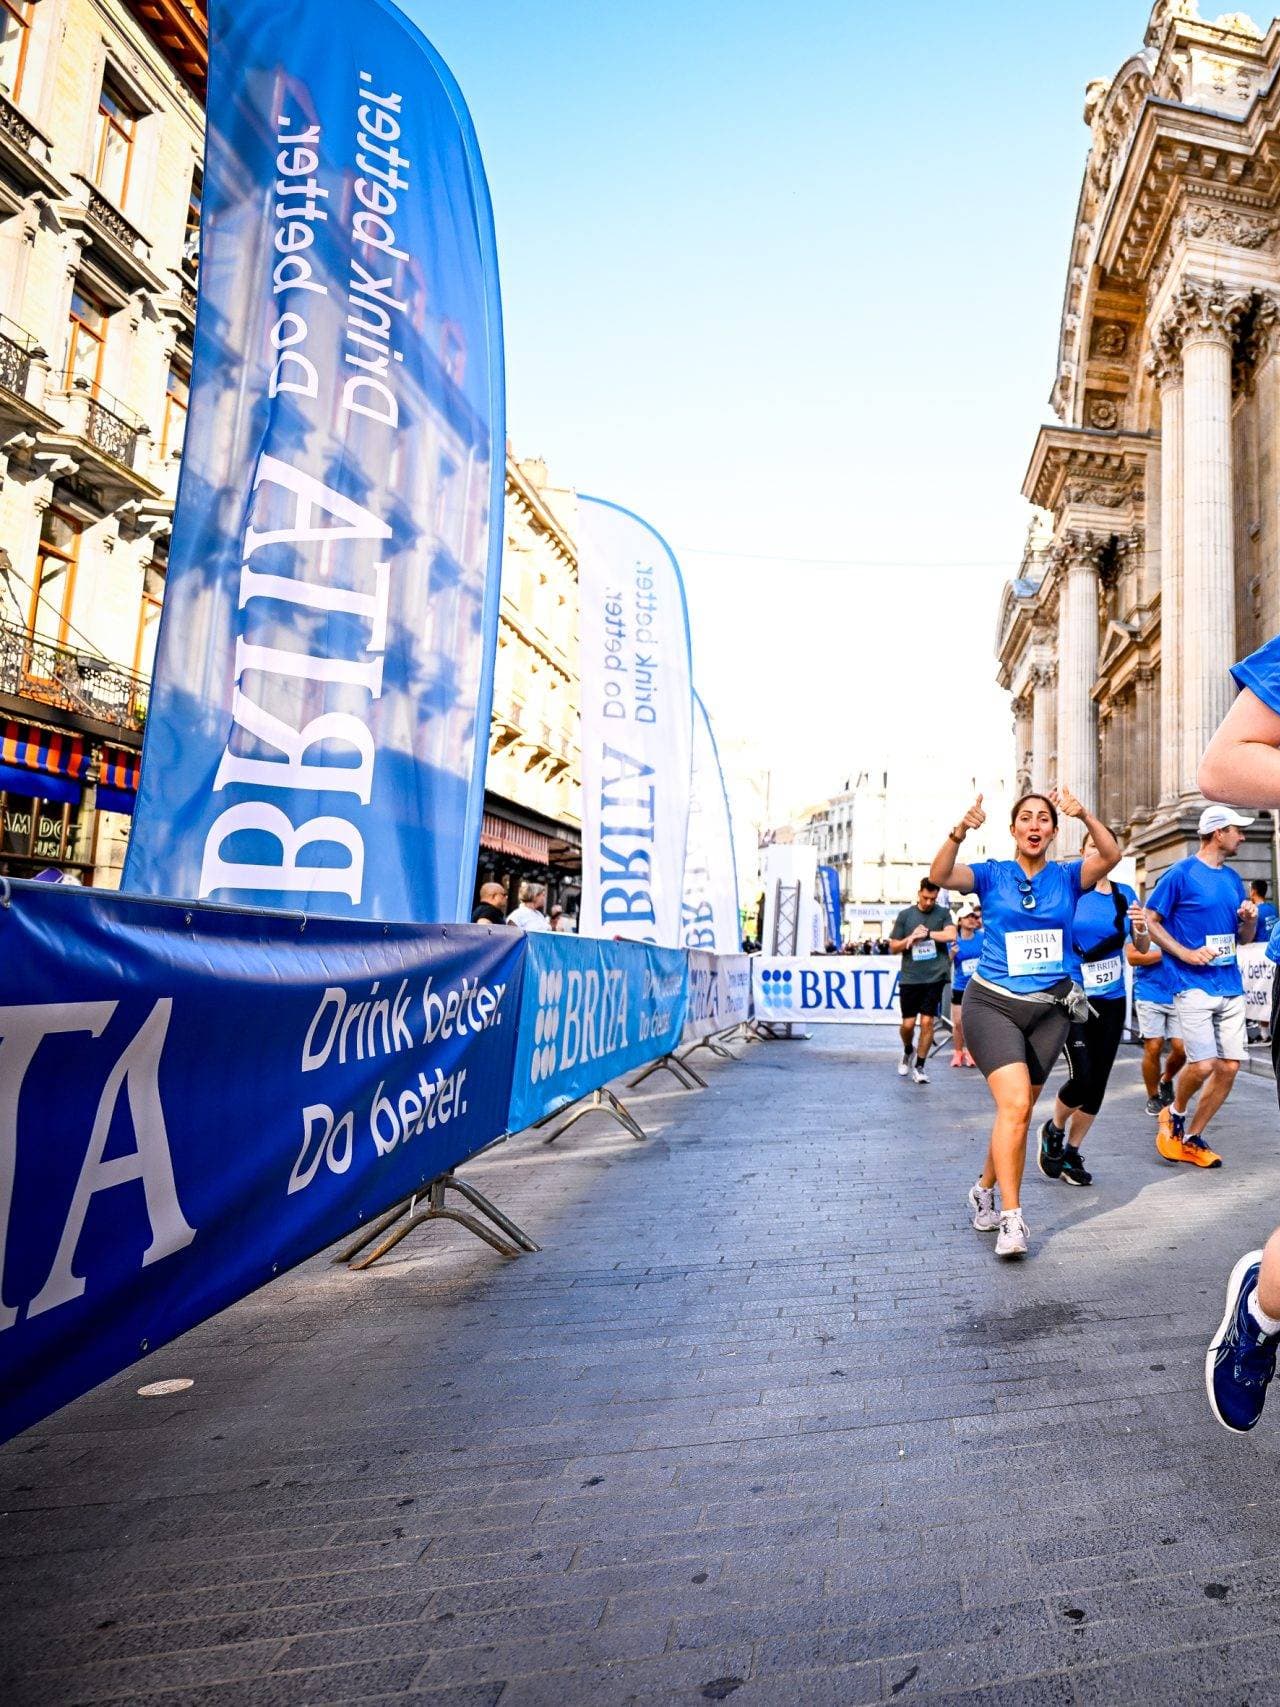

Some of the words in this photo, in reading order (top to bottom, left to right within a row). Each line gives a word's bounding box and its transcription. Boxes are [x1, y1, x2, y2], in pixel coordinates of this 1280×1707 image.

[1026, 933, 1057, 944] BRITA
[1024, 947, 1049, 960] 751
[1097, 960, 1118, 972] BRITA
[1096, 972, 1113, 984] 521
[302, 976, 412, 1072] Drink
[423, 976, 506, 1044] better.
[287, 1103, 354, 1196] Do
[370, 1066, 468, 1157] better.
